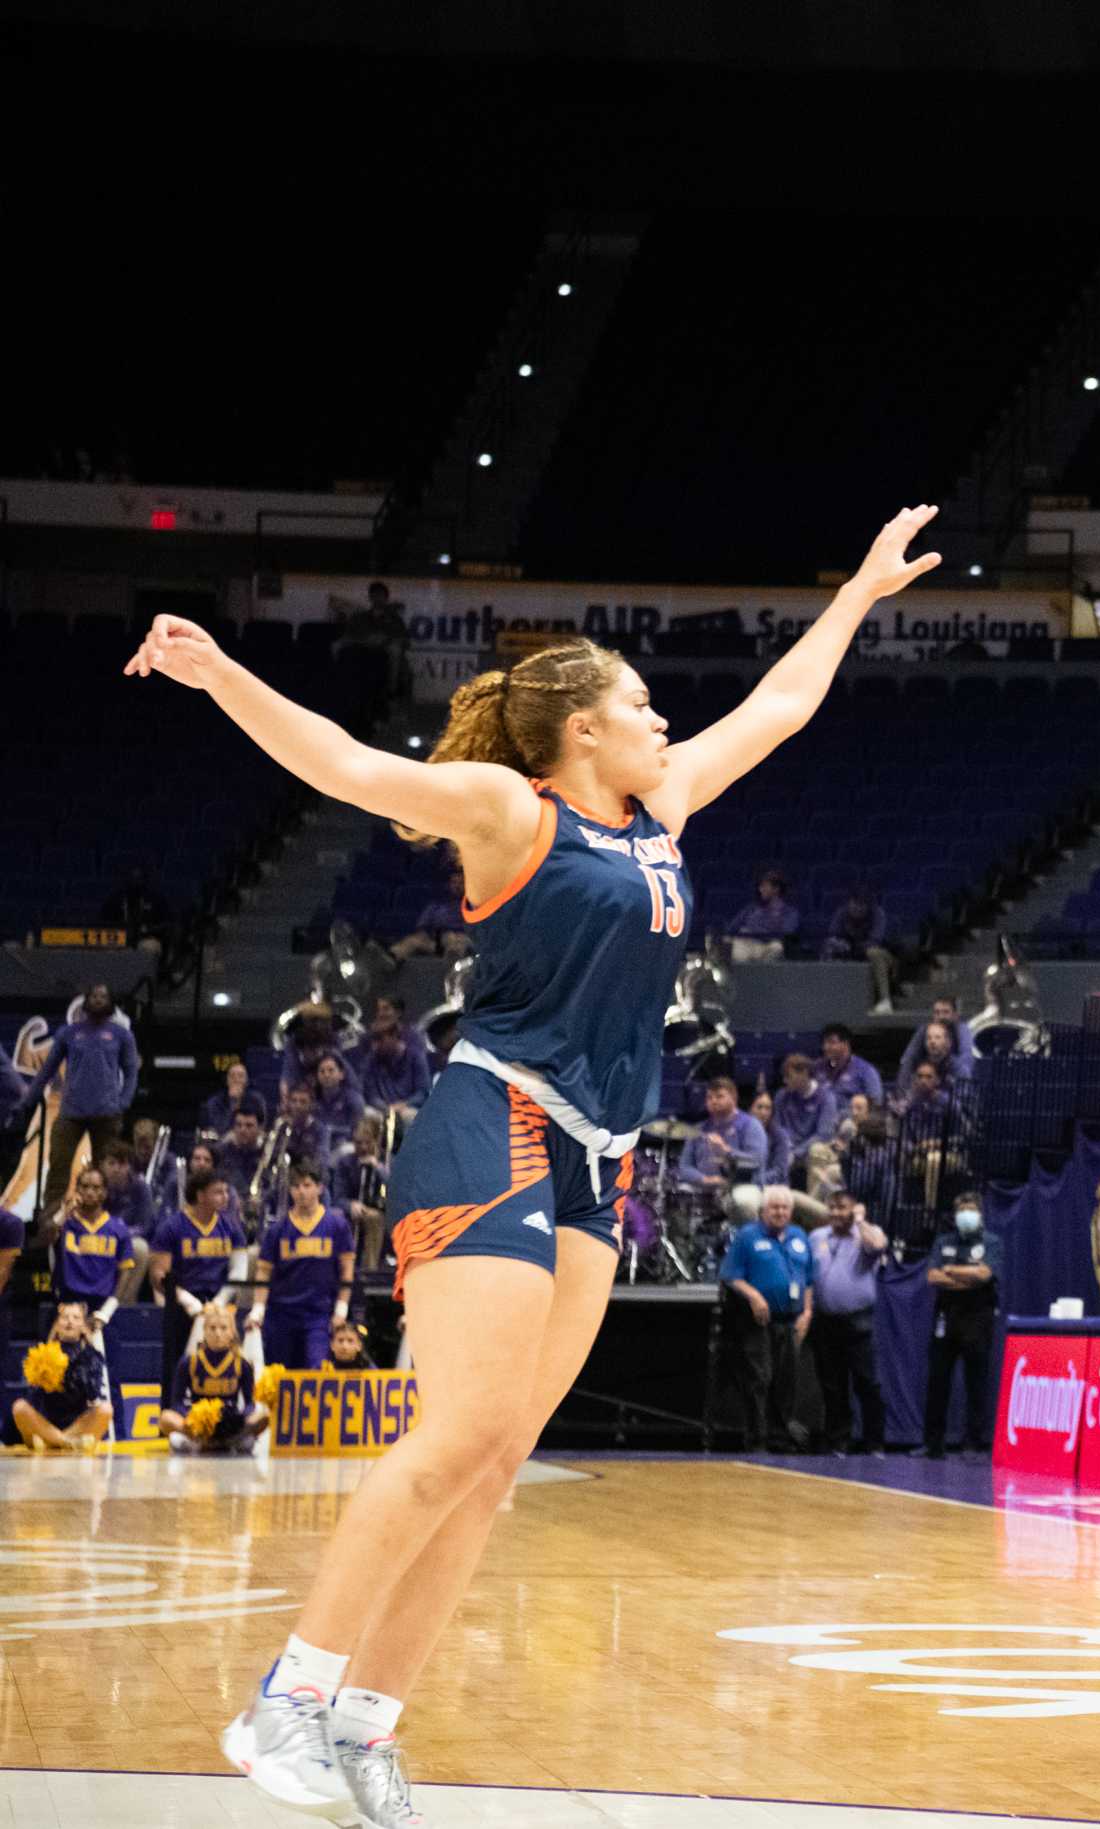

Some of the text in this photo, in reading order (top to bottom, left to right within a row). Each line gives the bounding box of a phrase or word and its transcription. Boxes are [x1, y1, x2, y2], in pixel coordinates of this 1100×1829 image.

[404, 605, 1049, 646] outhern AIR Serg Louisiana
[638, 865, 685, 938] 13
[276, 1378, 418, 1446] DEFENSE
